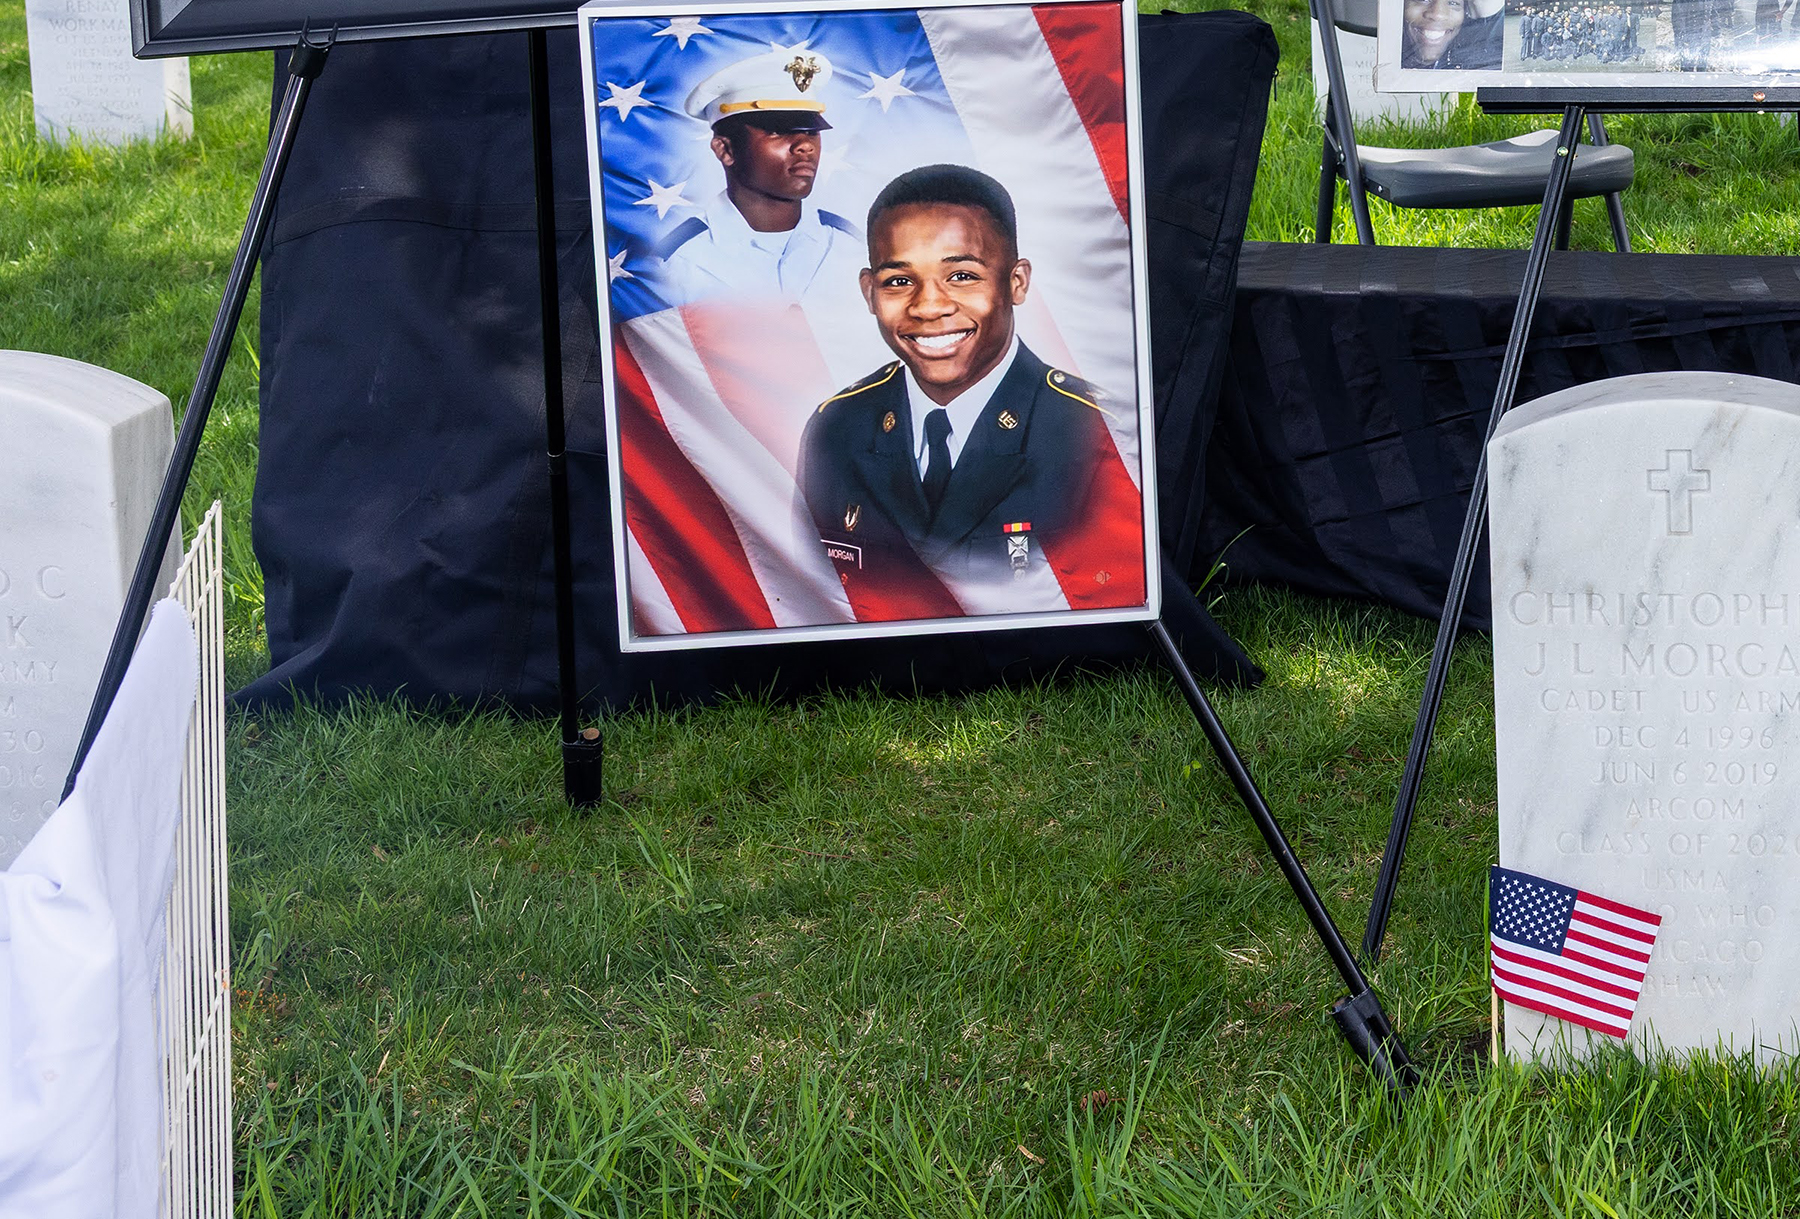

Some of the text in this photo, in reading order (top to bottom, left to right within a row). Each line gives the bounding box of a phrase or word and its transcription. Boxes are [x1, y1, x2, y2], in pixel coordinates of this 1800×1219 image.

[66, 0, 120, 13] RENAY
[50, 17, 128, 32] WORKMA
[1523, 642, 1547, 677] J
[1572, 642, 1595, 676] L
[1540, 688, 1647, 713] CADET
[1681, 689, 1718, 713] US
[1594, 725, 1776, 750] DEC 4 1996
[1592, 761, 1779, 785] JUN 6 2019
[1625, 797, 1746, 822] ARCOM
[1555, 831, 1653, 857] CLASS
[1667, 832, 1711, 857] OF
[1643, 868, 1729, 892] USMA
[1695, 904, 1777, 928] WHO
[1657, 938, 1765, 964] ICAGO
